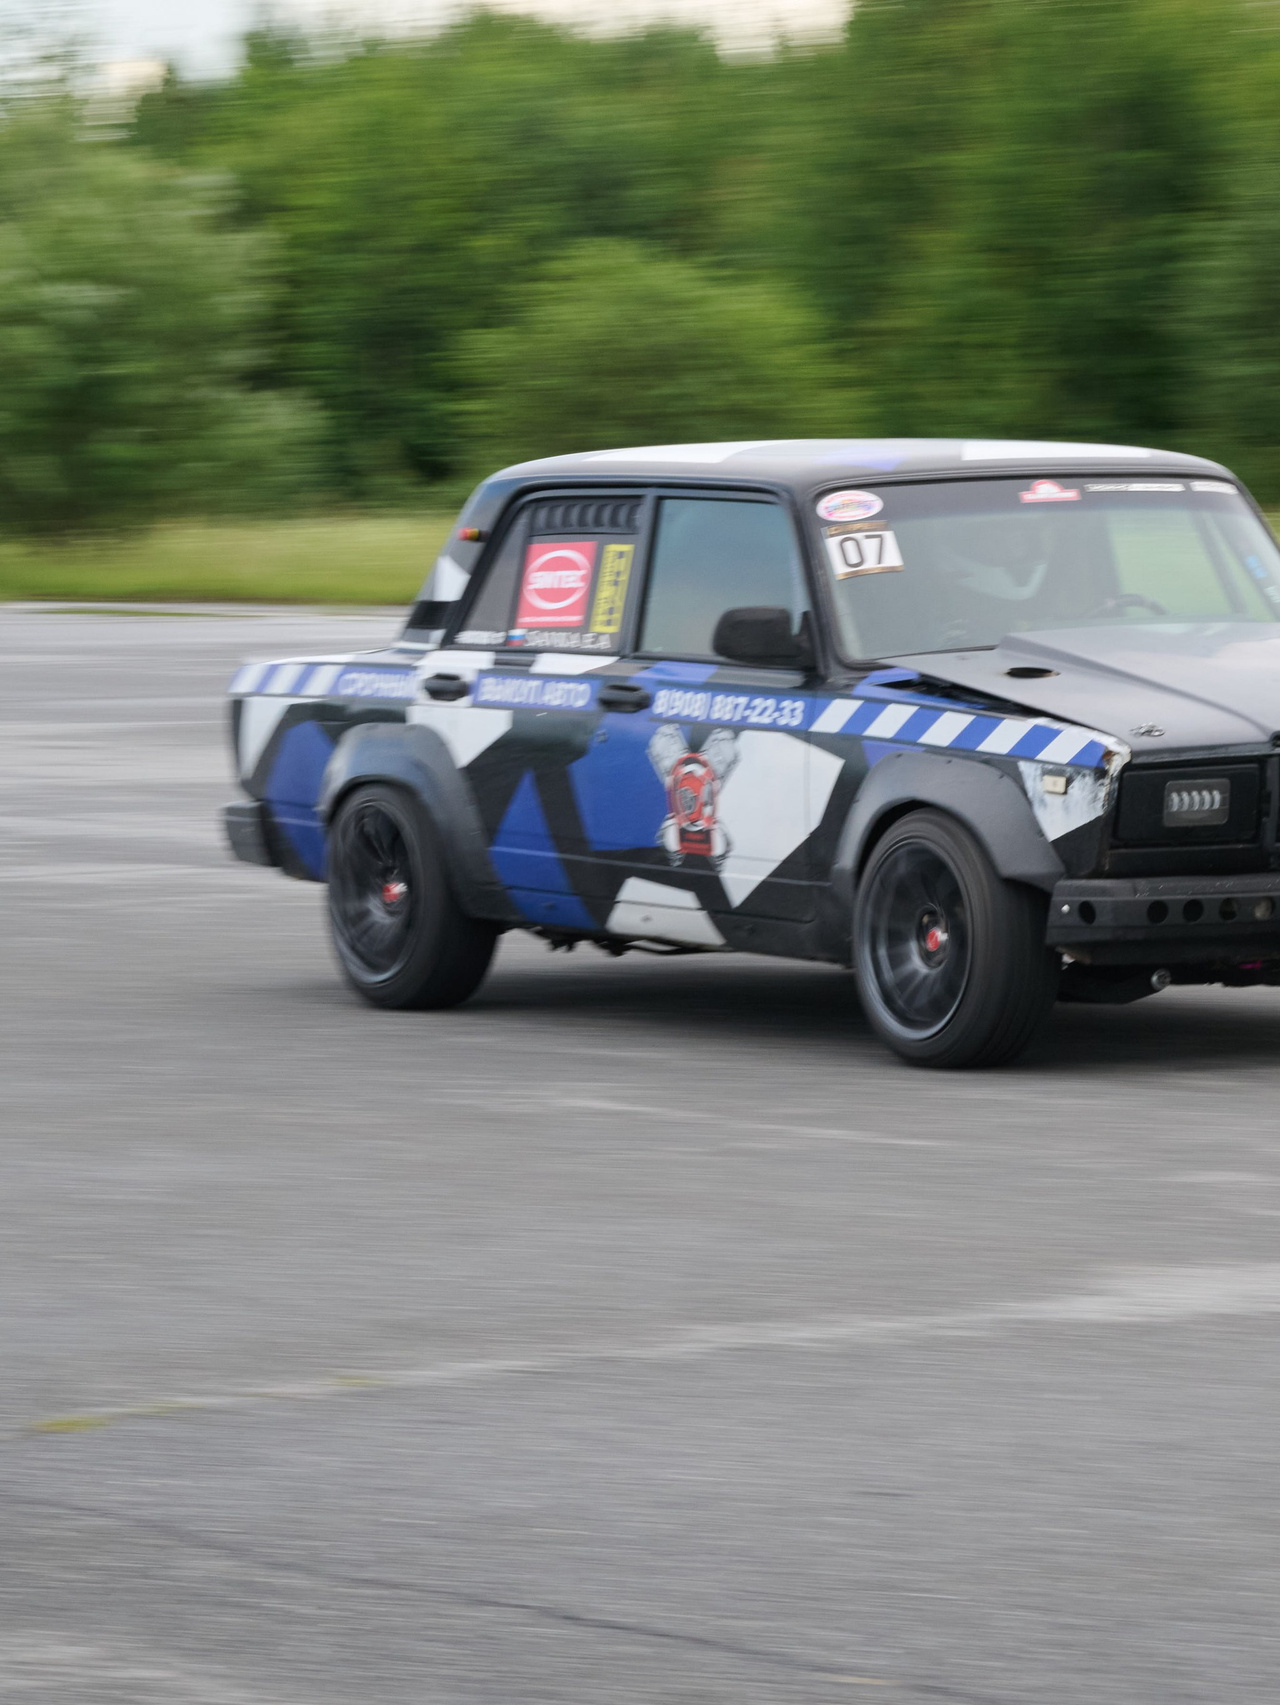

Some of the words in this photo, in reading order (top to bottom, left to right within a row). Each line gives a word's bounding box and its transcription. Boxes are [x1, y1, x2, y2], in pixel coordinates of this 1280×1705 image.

[840, 535, 883, 568] 07
[652, 689, 712, 721] 8(908)
[709, 694, 805, 727] 887-22-33
